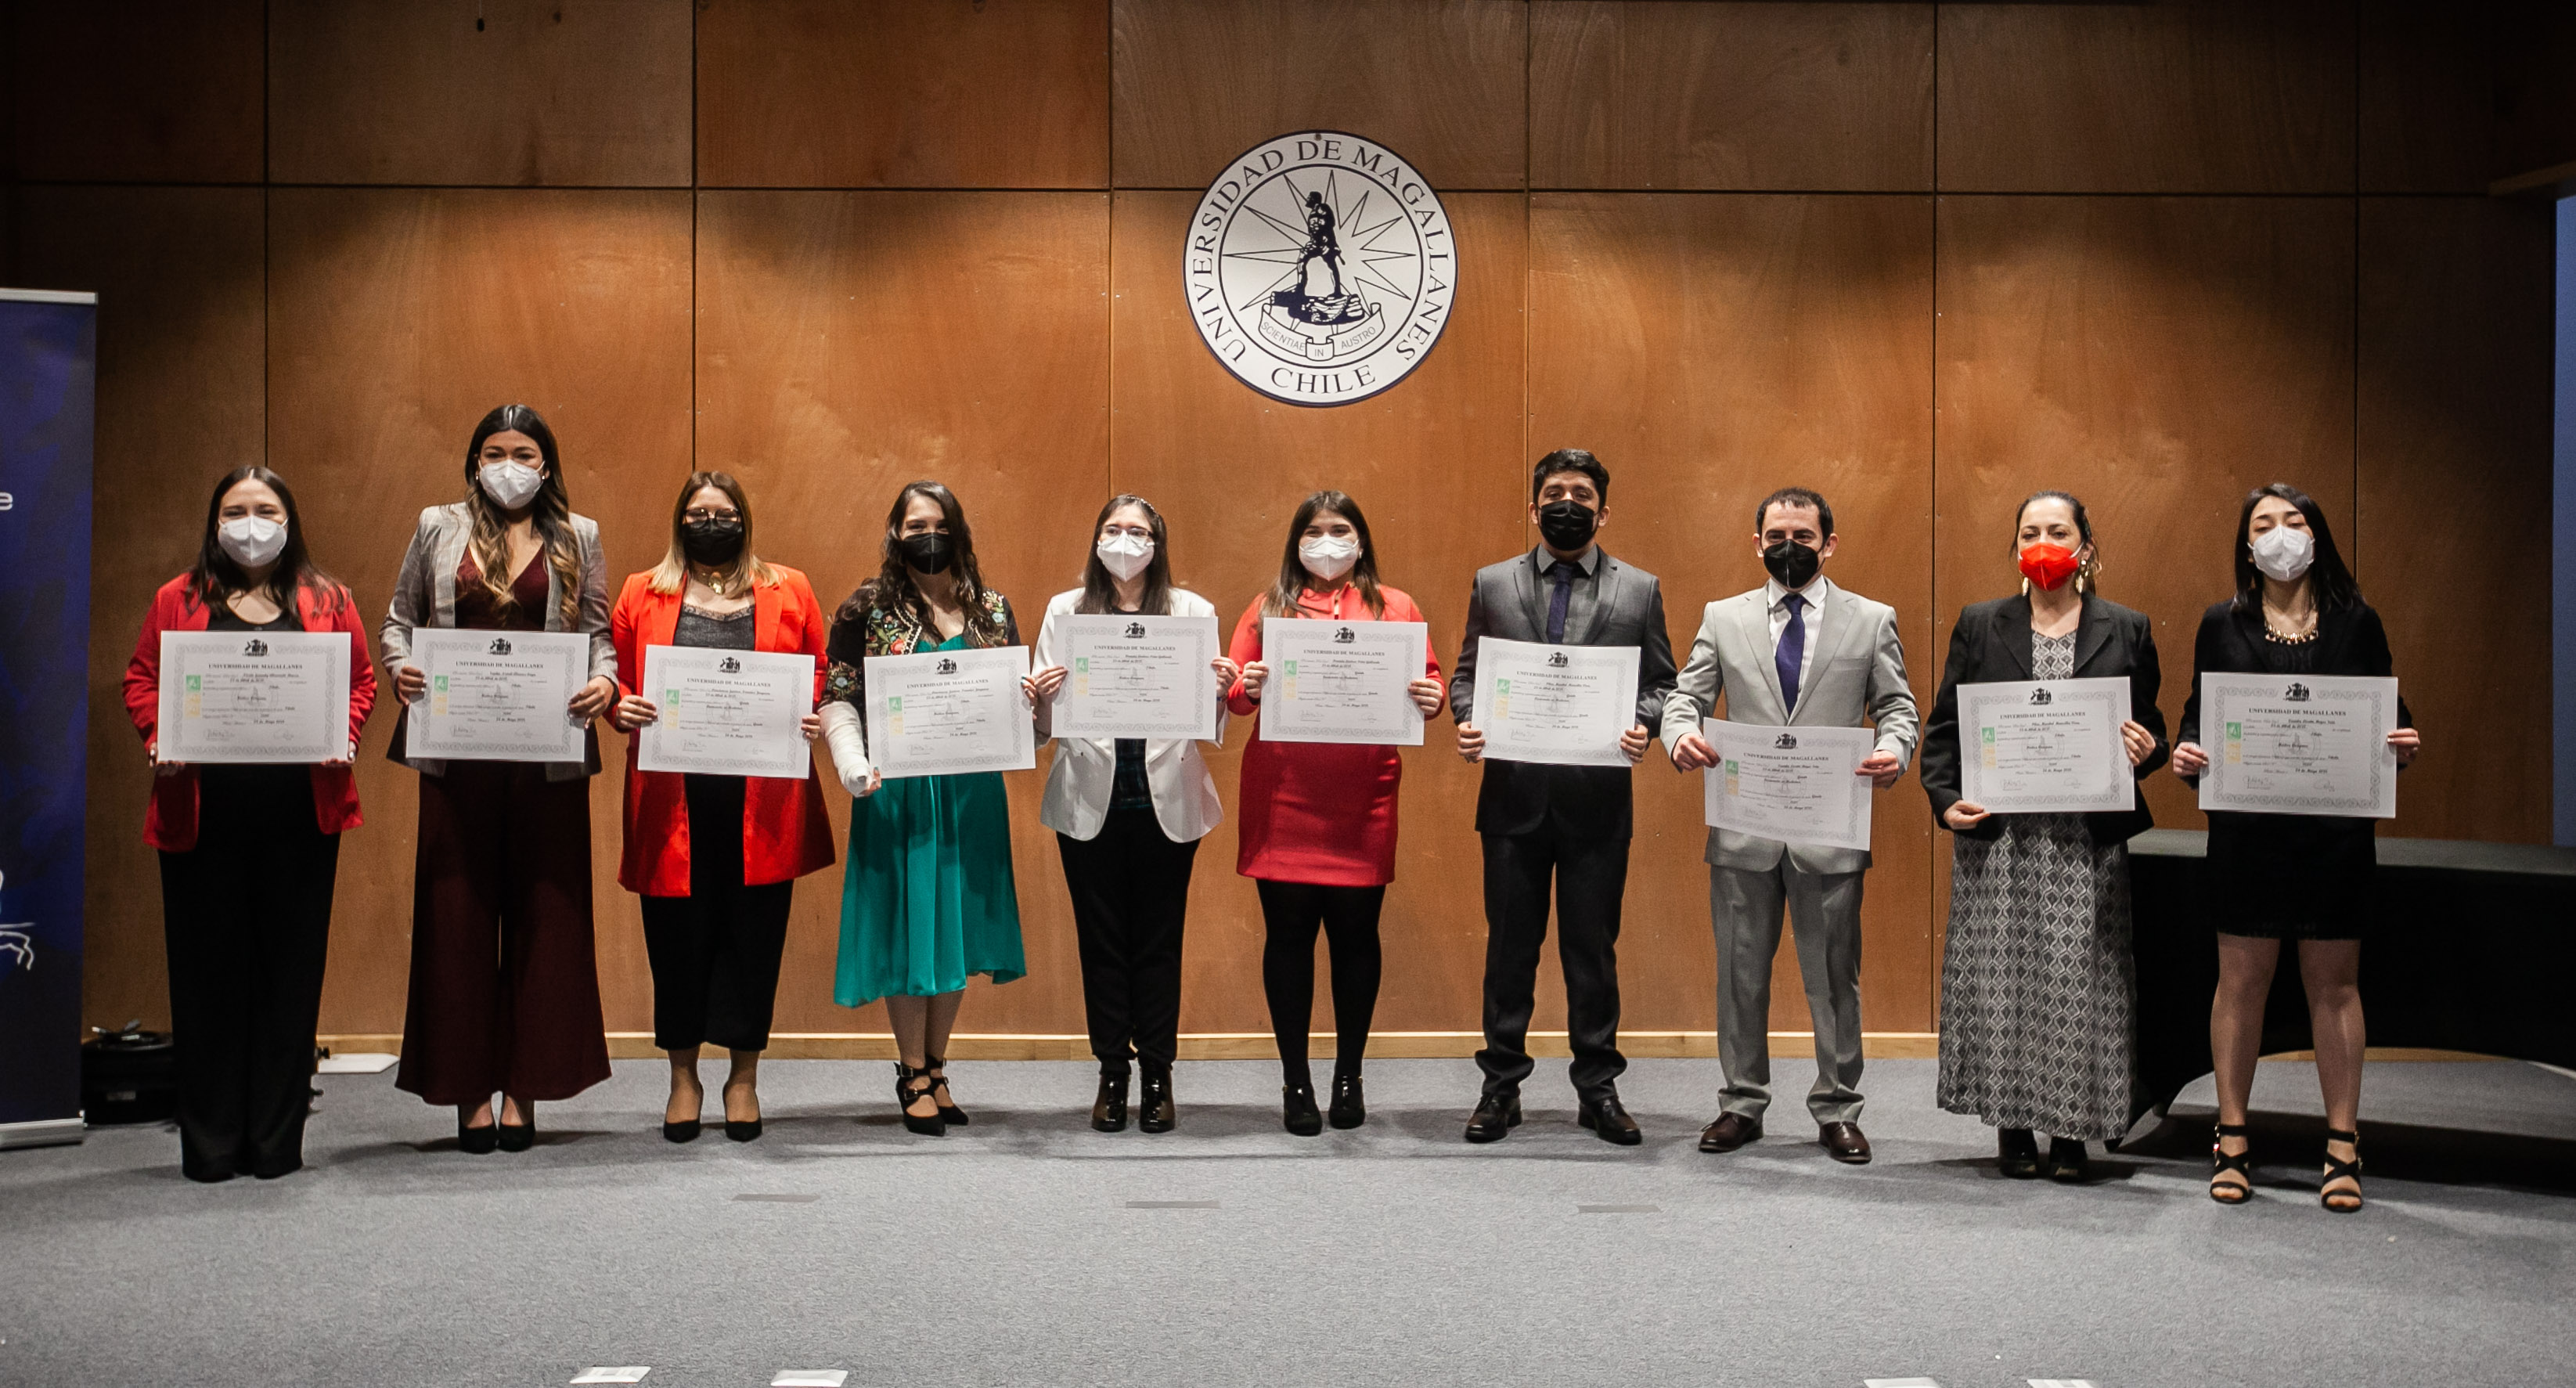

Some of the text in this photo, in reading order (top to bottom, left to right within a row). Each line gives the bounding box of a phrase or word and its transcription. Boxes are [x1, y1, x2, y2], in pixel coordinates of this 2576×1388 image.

[1192, 139, 1450, 363] UNIVERSIDAD DE MAGALLANES
[1260, 321, 1377, 357] SCIENTIAE IN AUSTRO
[1271, 364, 1376, 394] CHILE
